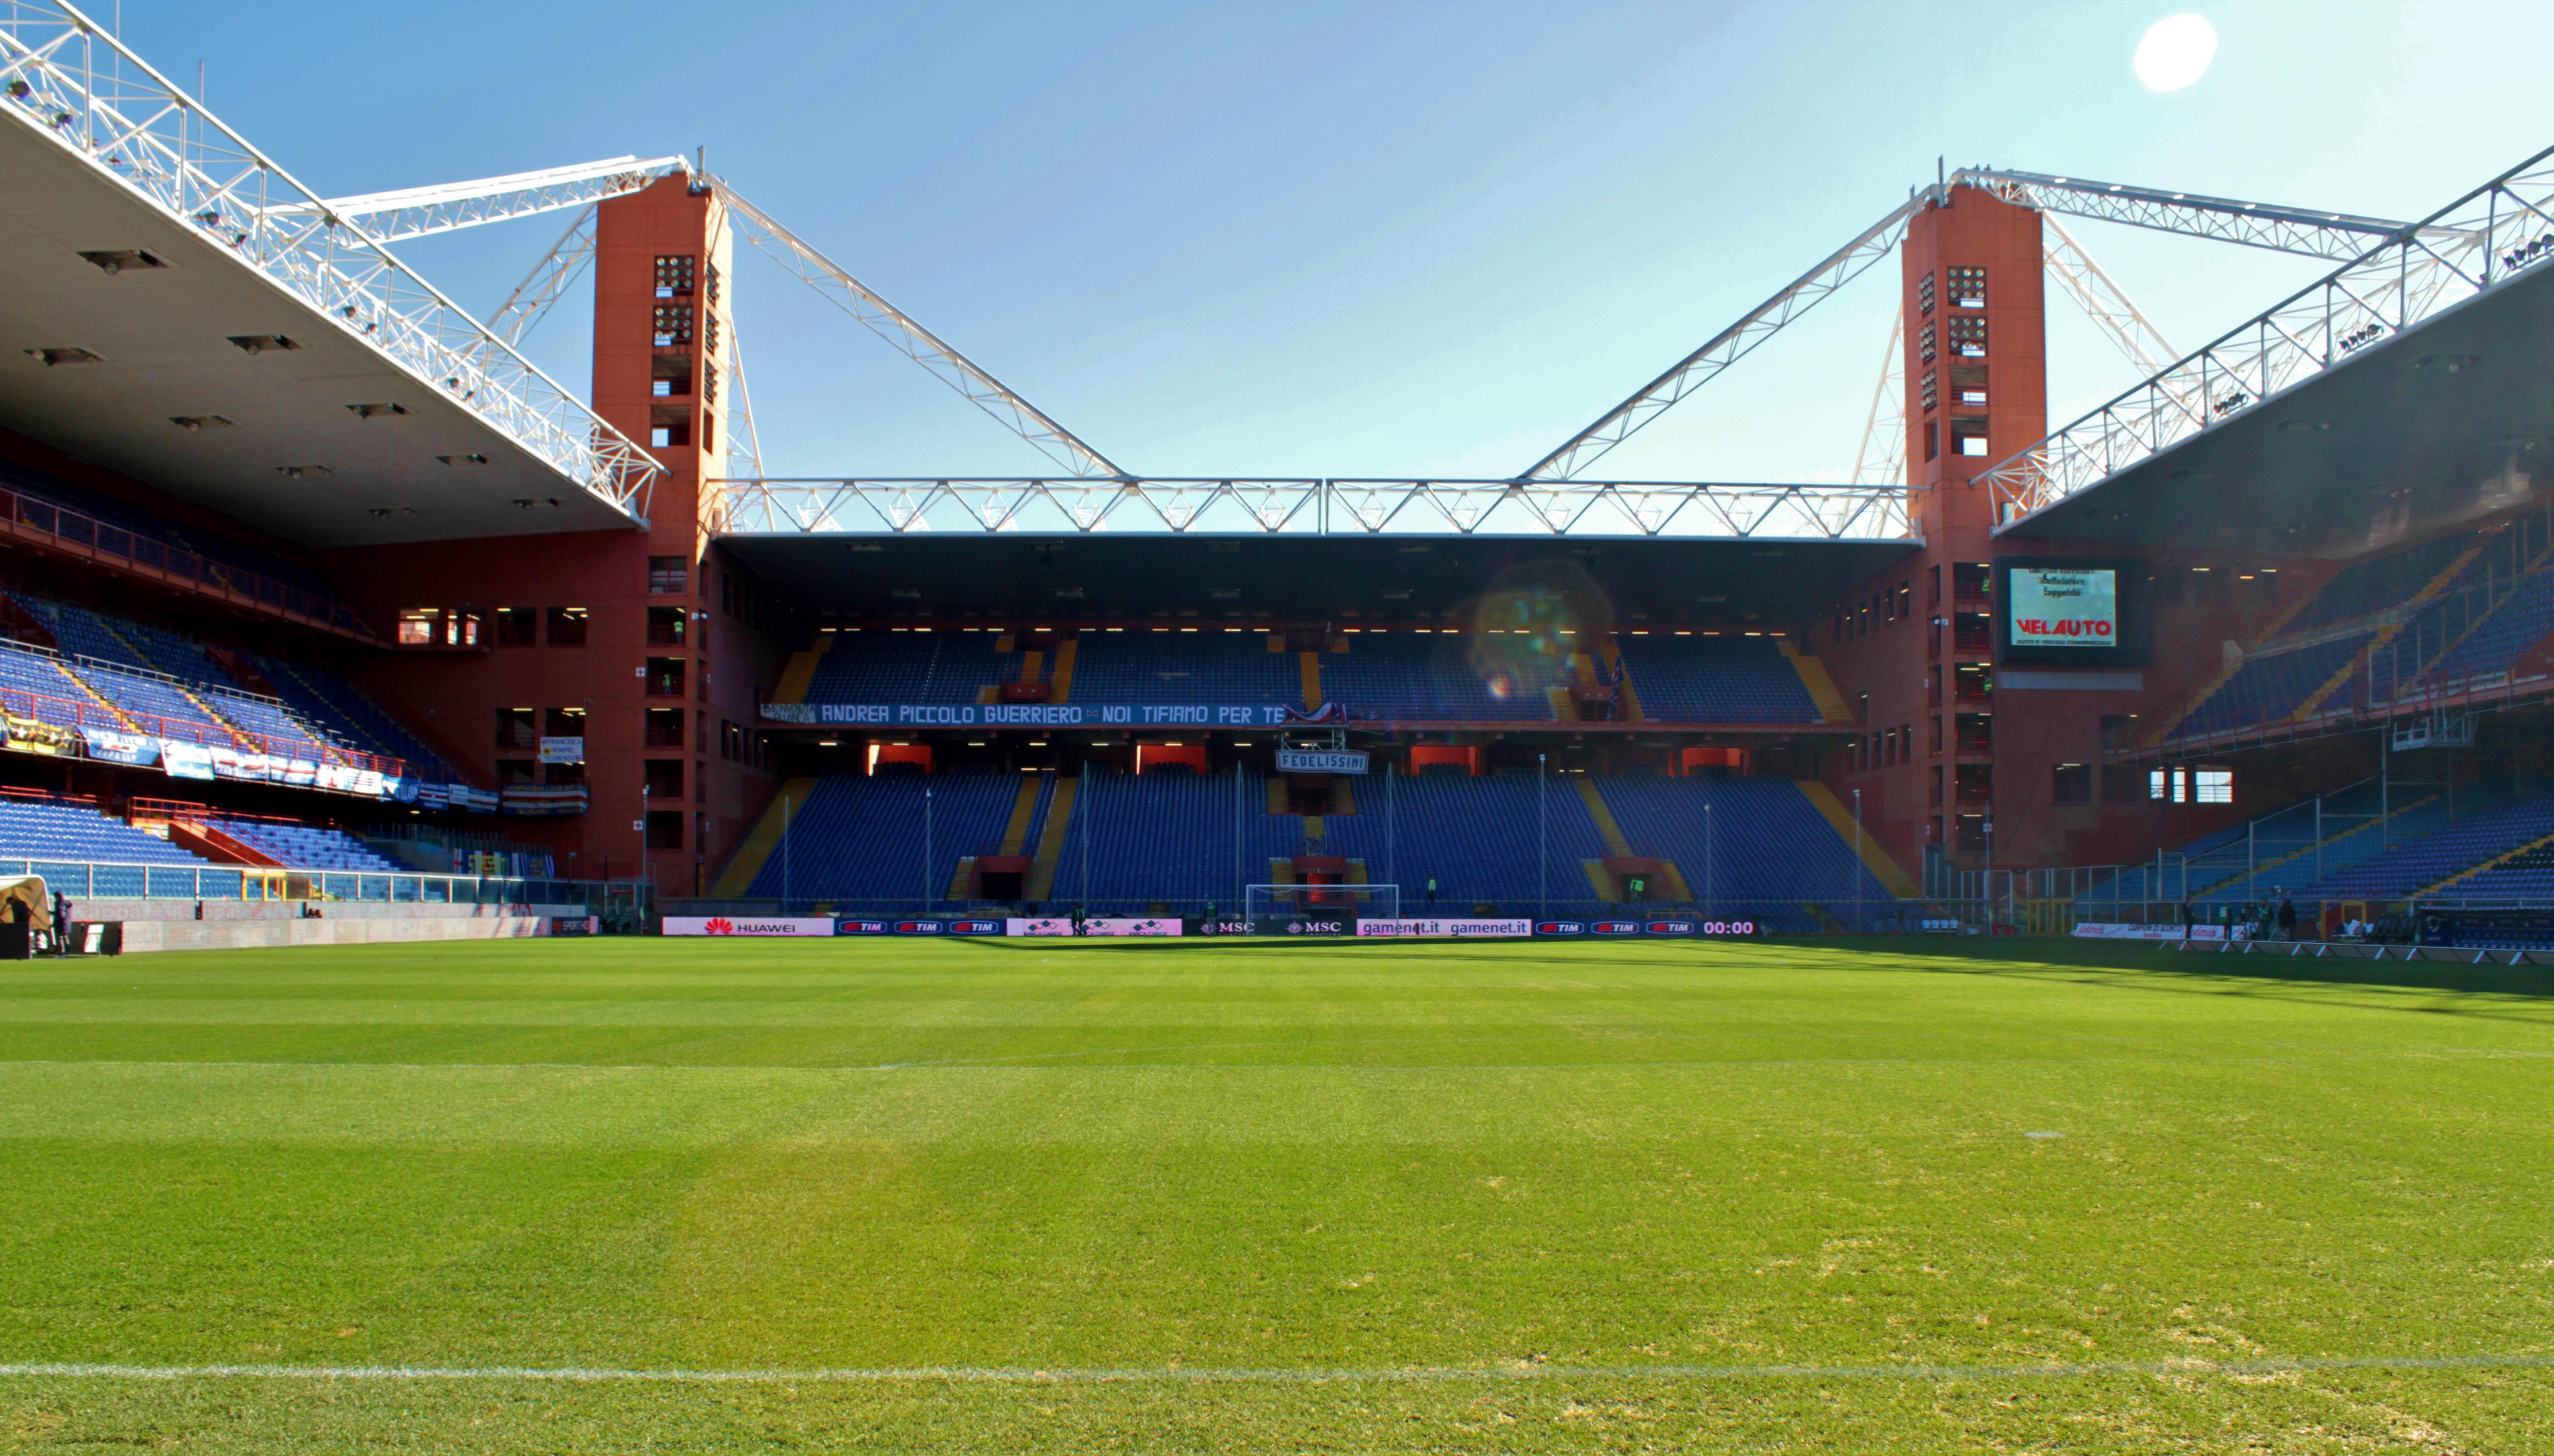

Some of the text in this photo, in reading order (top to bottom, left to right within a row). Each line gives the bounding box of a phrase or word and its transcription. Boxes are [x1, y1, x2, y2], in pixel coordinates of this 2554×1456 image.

[2016, 619, 2112, 636] VELAUTO
[822, 705, 1285, 724] ANDREA PICCOLO GUERRIERO NOI TIFIAMO PER TE
[1283, 755, 1363, 768] FEDELISSIMI
[1219, 923, 1255, 931] MSC
[1306, 922, 1341, 931] MSC
[1451, 921, 1526, 935] gamenet.it
[1704, 922, 1753, 934] 00:00
[2191, 926, 2219, 938] ederici
